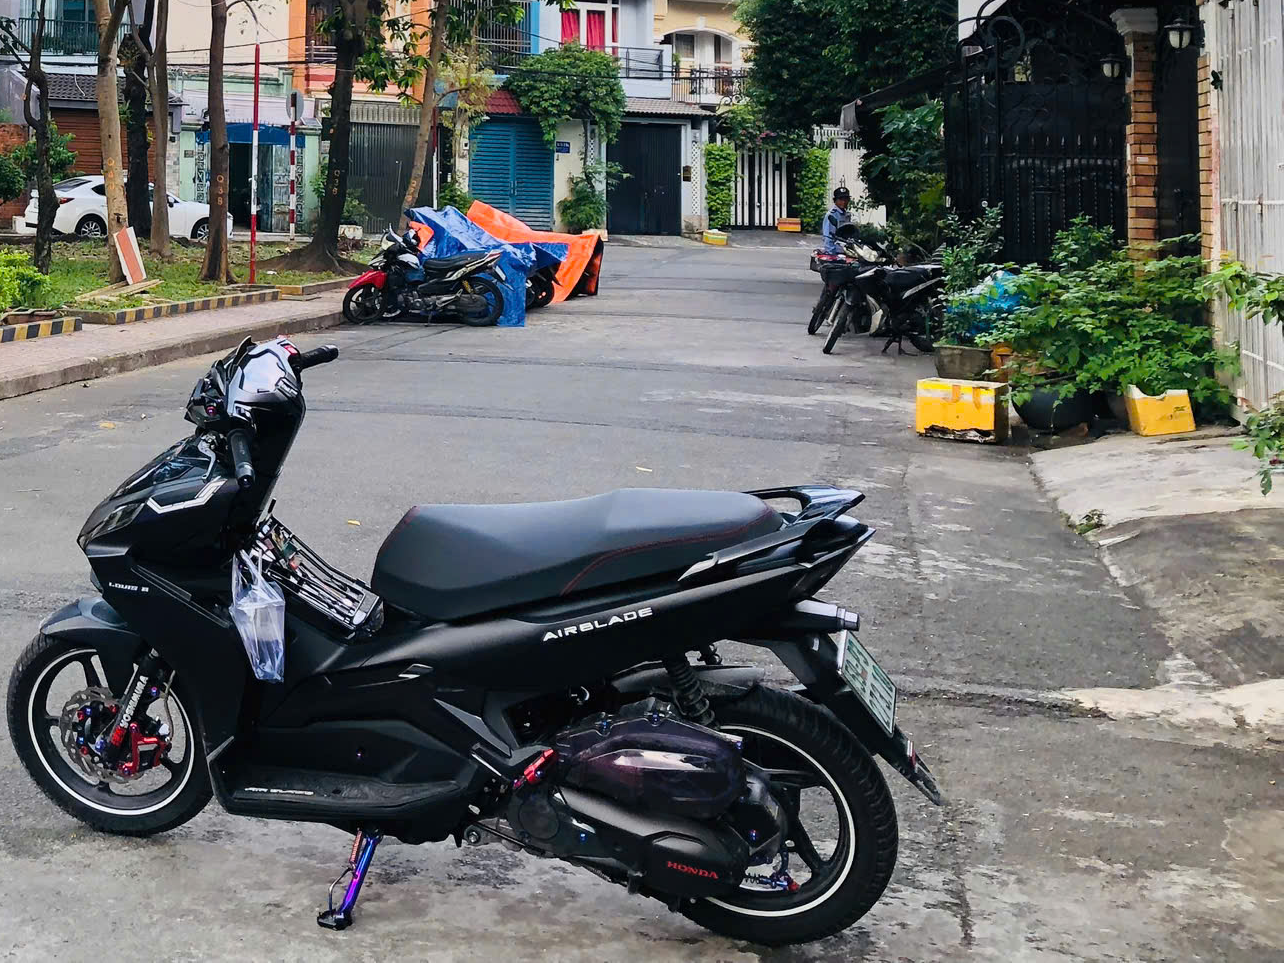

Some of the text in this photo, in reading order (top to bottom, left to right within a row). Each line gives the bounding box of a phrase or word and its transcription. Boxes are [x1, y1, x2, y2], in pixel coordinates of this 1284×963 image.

[543, 607, 653, 641] AIRBLADE
[118, 675, 149, 729] YOSHIMURA
[667, 860, 719, 880] HONDA
